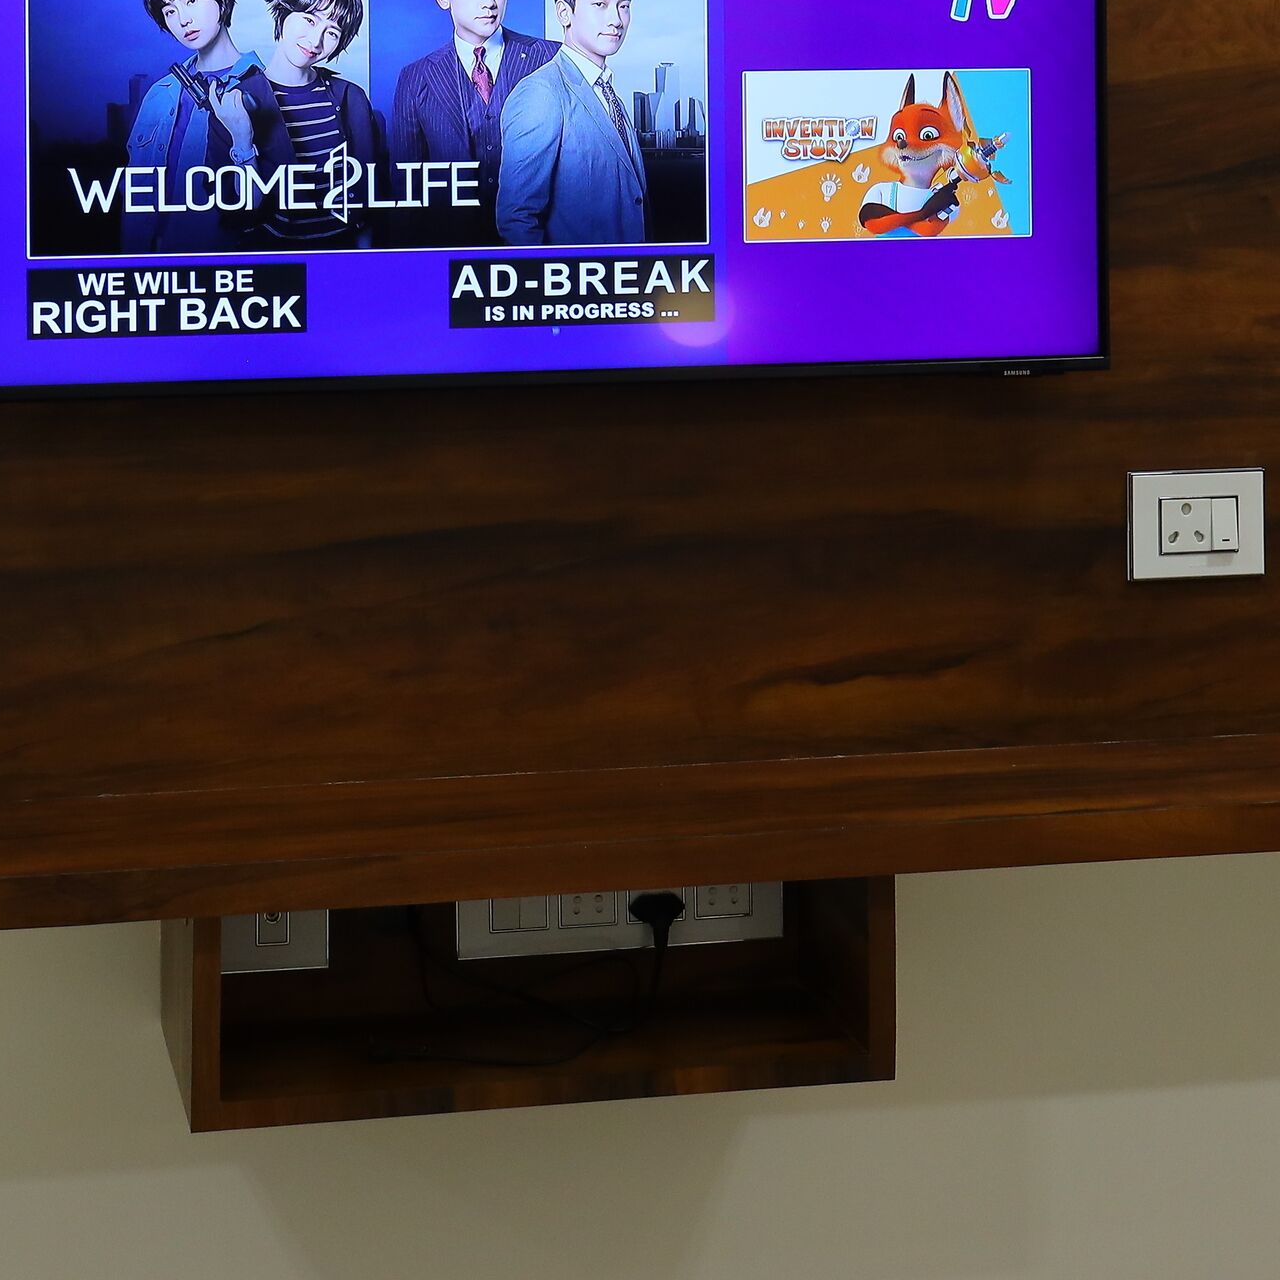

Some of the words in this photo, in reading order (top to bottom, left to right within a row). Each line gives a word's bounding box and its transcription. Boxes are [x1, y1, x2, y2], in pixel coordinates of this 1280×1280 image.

[763, 117, 877, 140] INVENTION
[782, 139, 851, 161] STORY
[78, 272, 125, 295] WE
[134, 271, 206, 294] WILL
[214, 270, 254, 292] BE
[452, 260, 710, 298] AD-BREAK
[33, 299, 166, 334] RIGHT
[179, 295, 302, 331] BACK
[485, 306, 505, 321] IS
[512, 305, 534, 320] IN
[541, 302, 655, 320] PROGRESS
